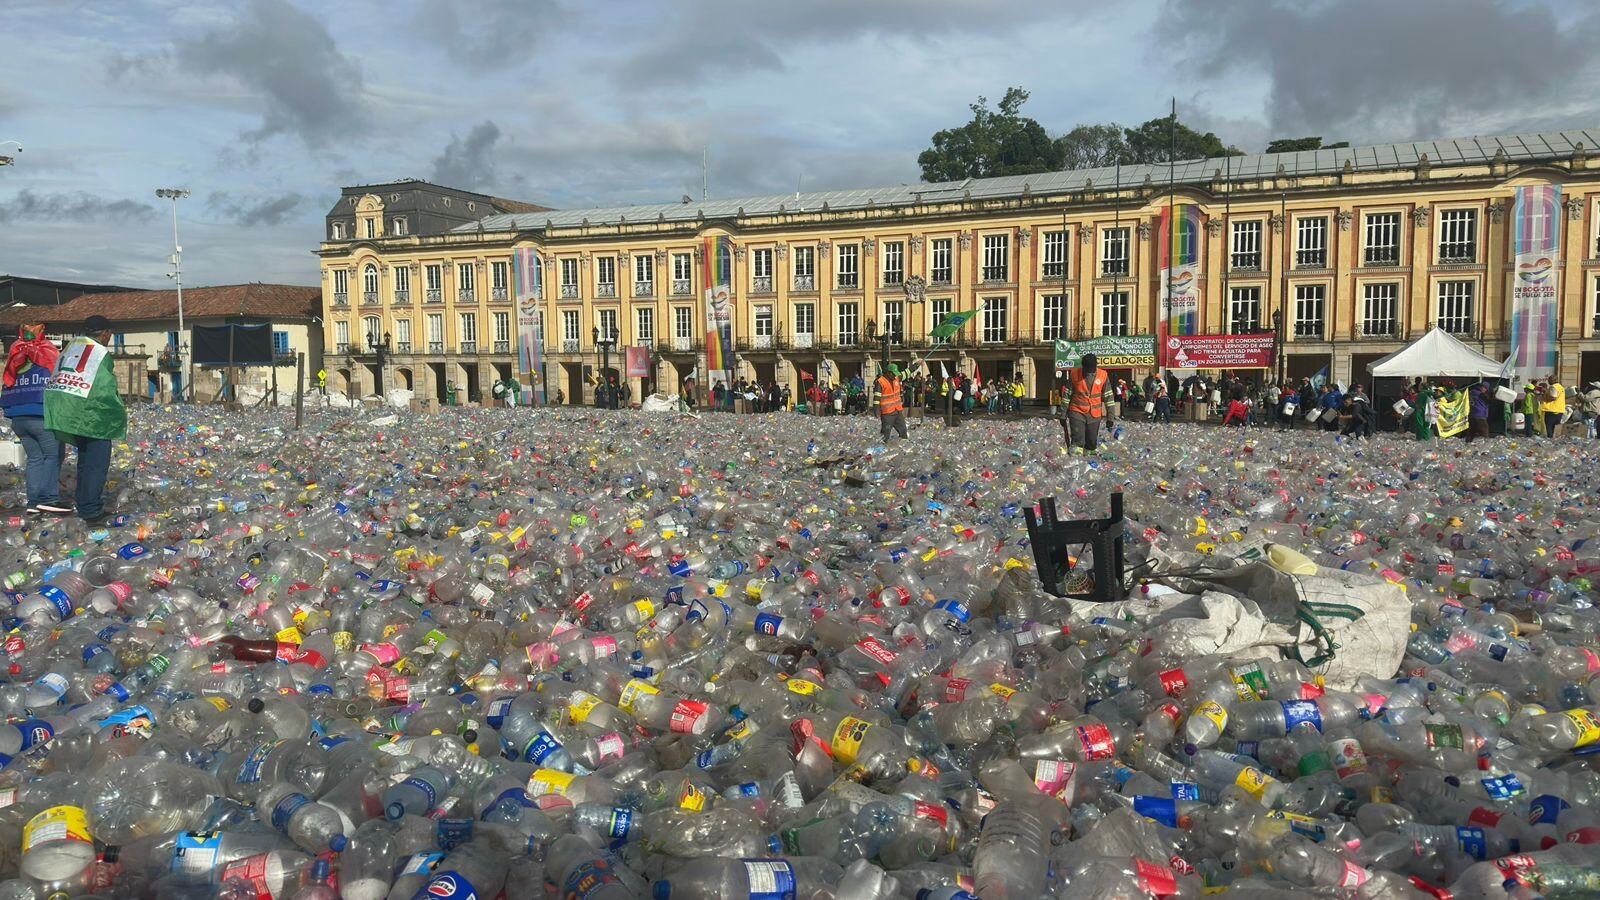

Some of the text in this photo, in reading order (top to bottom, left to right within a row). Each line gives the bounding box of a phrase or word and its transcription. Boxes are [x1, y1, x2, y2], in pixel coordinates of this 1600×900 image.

[1096, 356, 1154, 365] CICLADORES
[20, 375, 29, 386] de
[59, 373, 84, 382] ERTA
